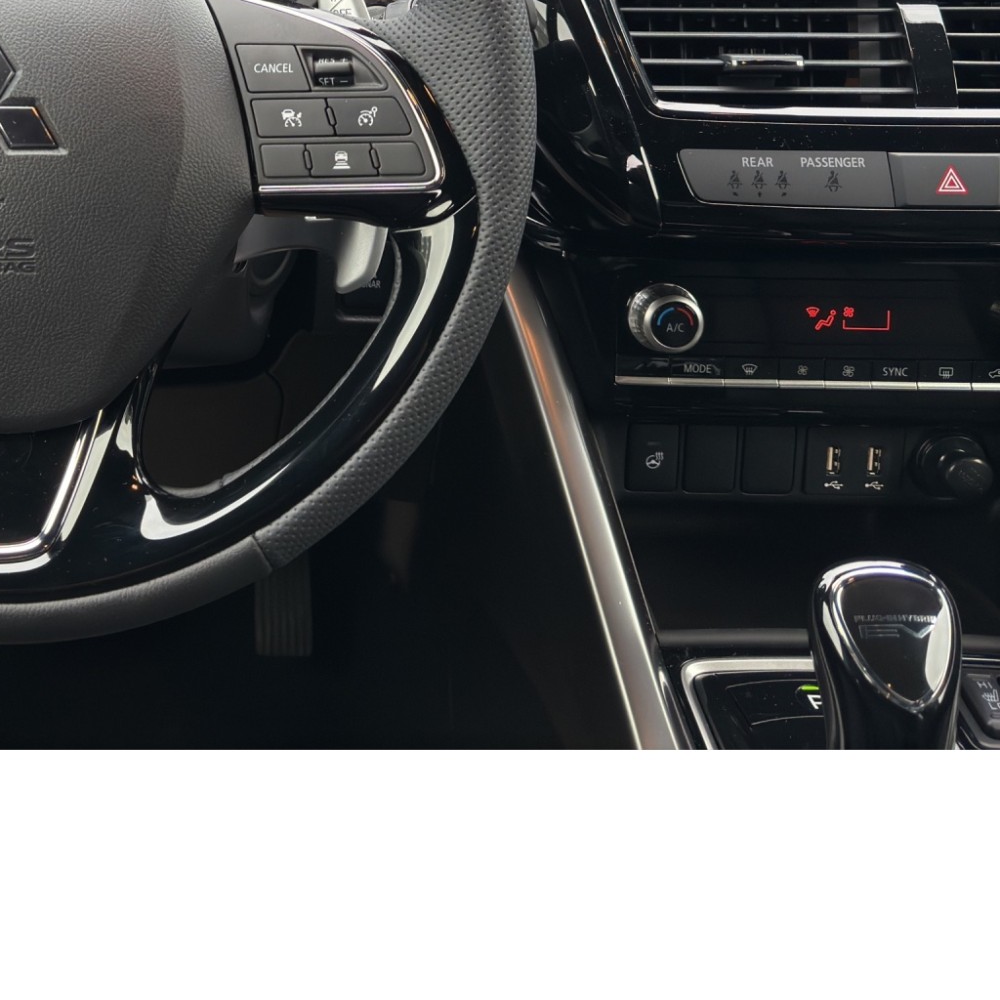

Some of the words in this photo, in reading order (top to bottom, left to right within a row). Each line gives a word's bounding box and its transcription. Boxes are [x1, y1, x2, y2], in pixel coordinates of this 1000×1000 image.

[254, 63, 294, 73] CANCEL
[741, 157, 774, 167] REAR
[800, 157, 866, 168] PASSENGER
[666, 322, 685, 333] A/C
[683, 364, 712, 374] MODE
[882, 366, 909, 377] SYNC
